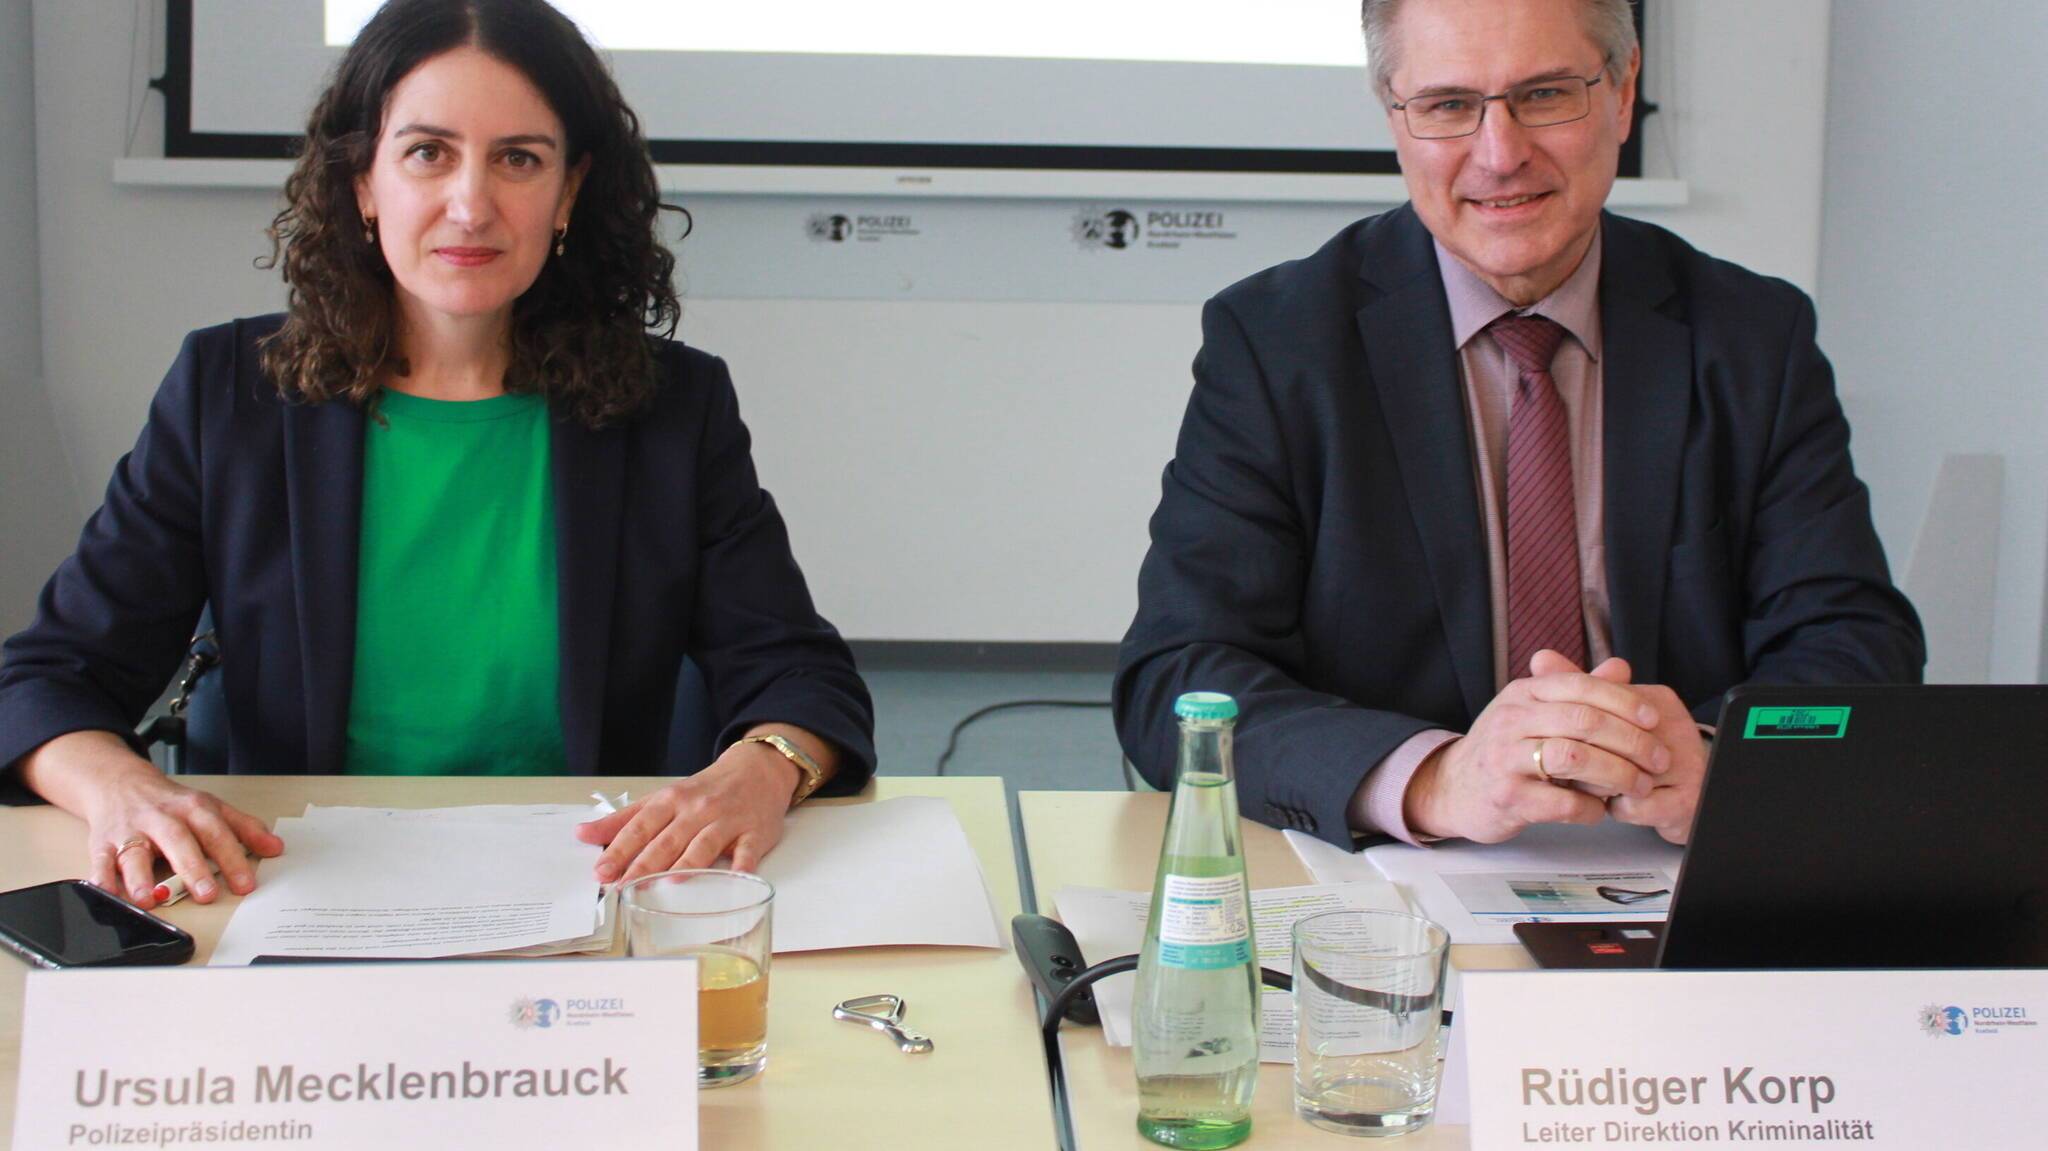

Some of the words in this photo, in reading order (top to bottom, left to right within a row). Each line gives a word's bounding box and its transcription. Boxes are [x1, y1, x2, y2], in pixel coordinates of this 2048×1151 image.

[857, 215, 912, 228] POLIZEI
[1147, 211, 1224, 228] POLIZEI
[566, 998, 624, 1010] POLIZEI
[1973, 1007, 2026, 1018] POLIZEI
[74, 1066, 235, 1109] Ursula
[254, 1057, 629, 1104] Mecklenbrauck
[1521, 1067, 1708, 1116] Rüdiger
[1723, 1066, 1836, 1114] Korp
[68, 1118, 313, 1149] Polizeipräsidentin
[1522, 1121, 1597, 1144] Leiter
[1604, 1120, 1720, 1143] Direktion
[1728, 1119, 1875, 1142] Kriminalität
